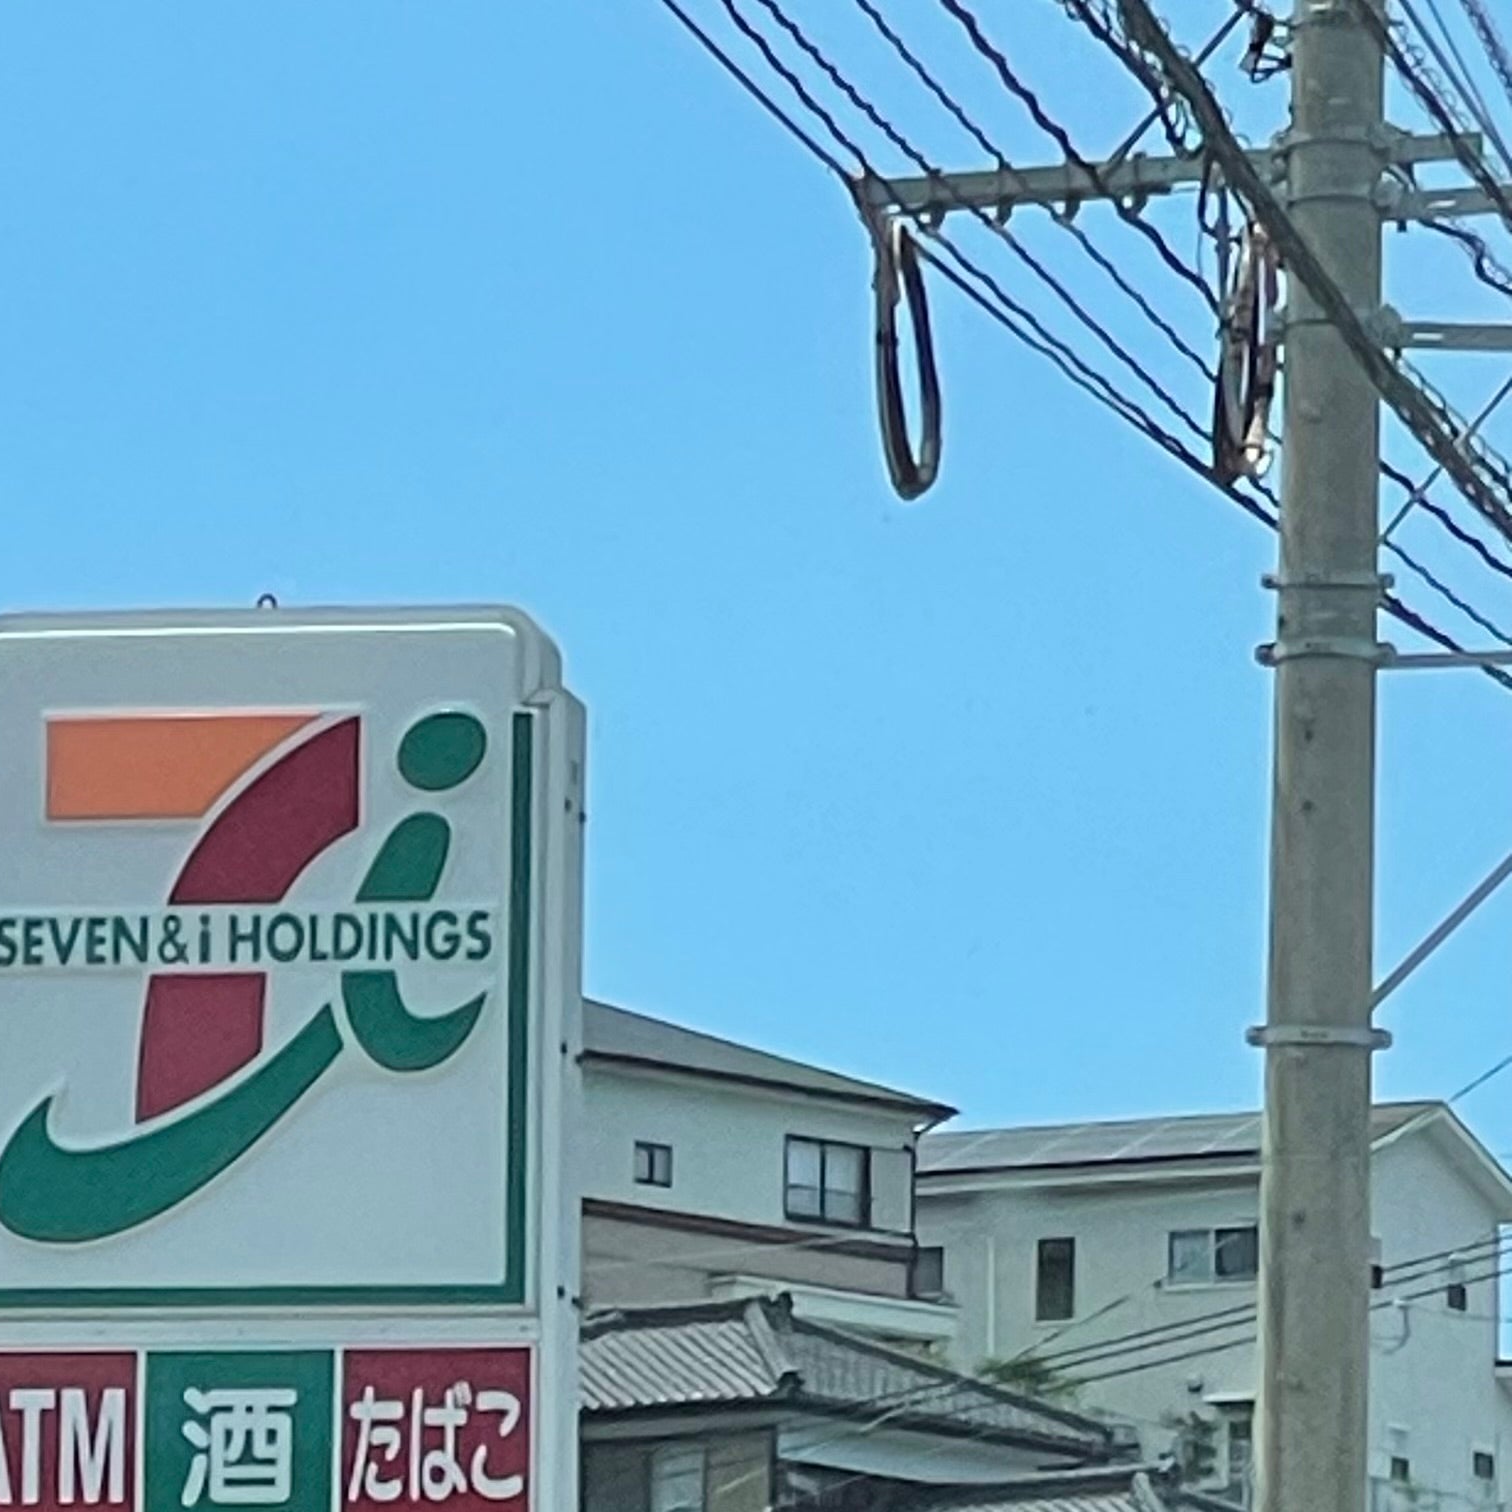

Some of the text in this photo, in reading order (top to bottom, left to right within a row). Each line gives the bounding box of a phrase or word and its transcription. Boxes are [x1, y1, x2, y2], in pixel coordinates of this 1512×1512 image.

[229, 909, 493, 963] HOLDINGS
[182, 1386, 298, 1507] 酒
[349, 1380, 524, 1503] たばこ
